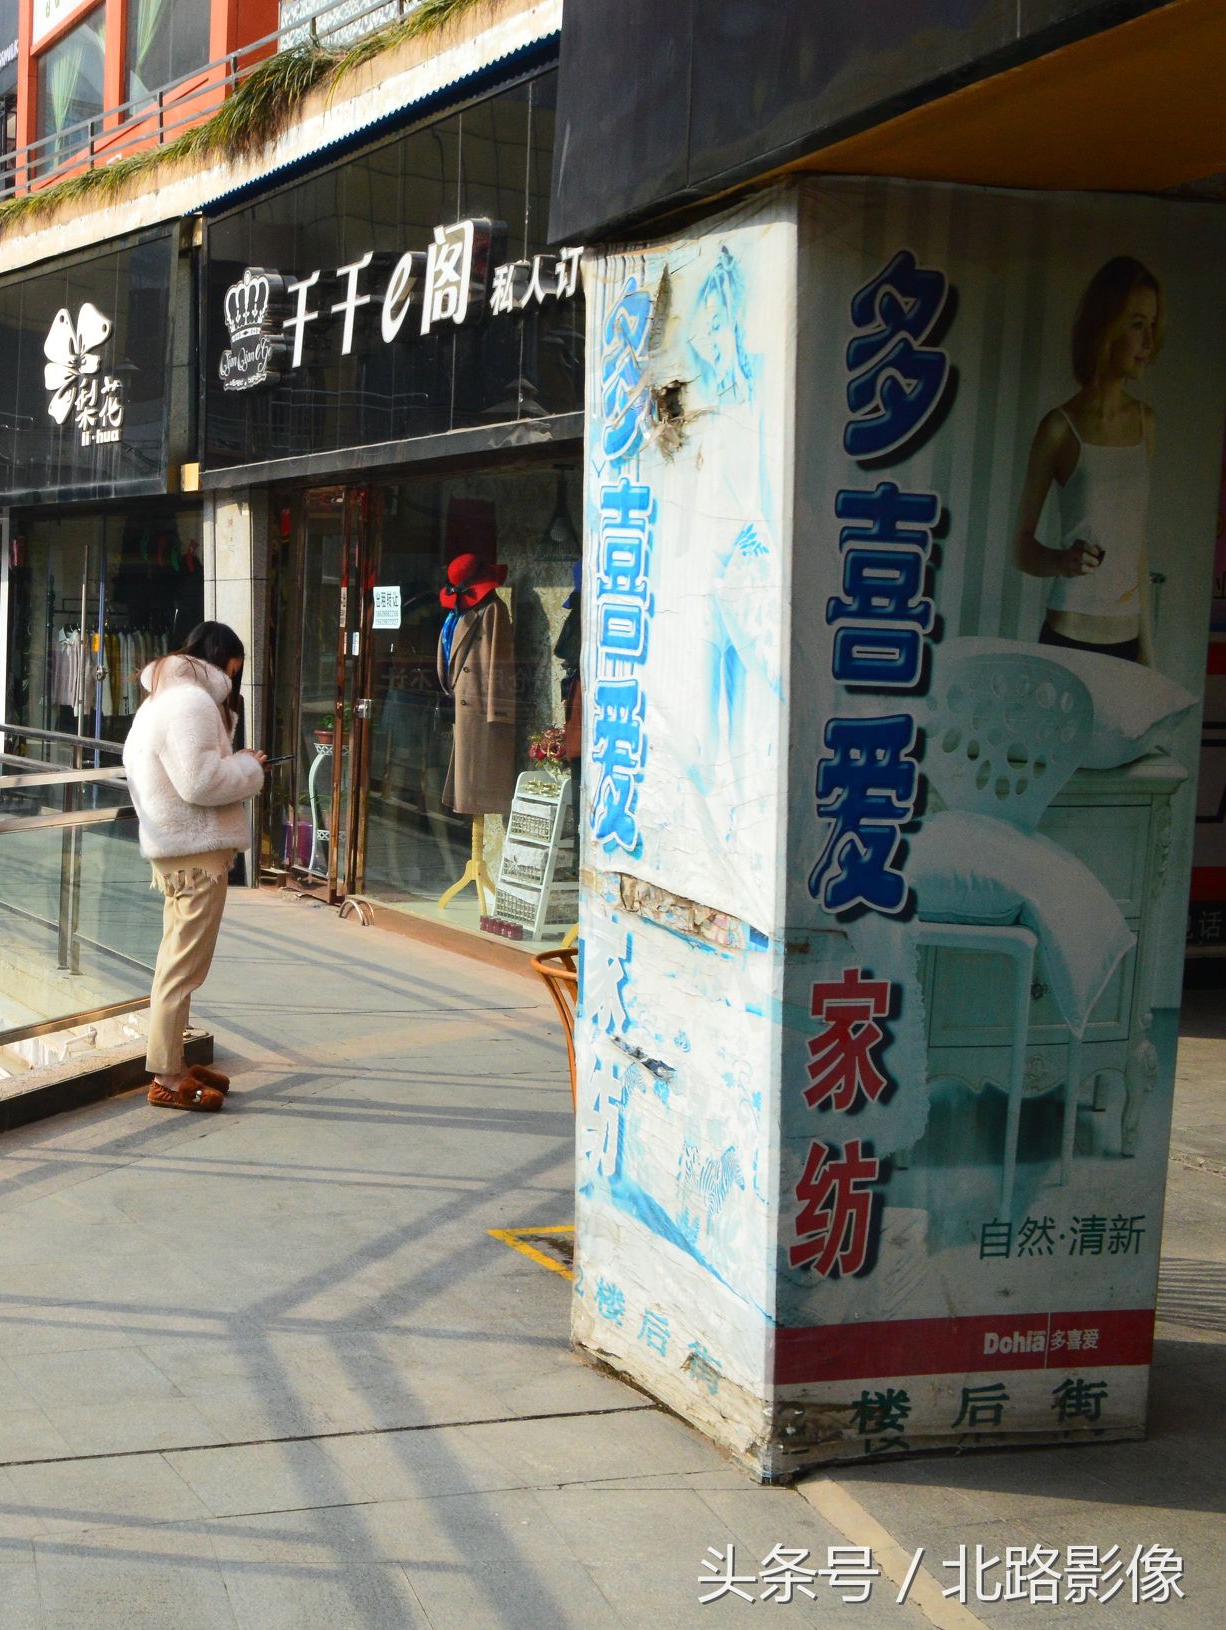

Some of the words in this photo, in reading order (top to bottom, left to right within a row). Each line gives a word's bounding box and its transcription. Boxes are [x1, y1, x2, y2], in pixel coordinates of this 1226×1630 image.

[283, 219, 474, 368] 千千e阁
[489, 246, 585, 316] 私人订
[75, 375, 124, 431] 梨花
[808, 248, 950, 915] 多喜爱
[789, 967, 894, 1280] 家纺
[1050, 1328, 1100, 1351] 多喜爱
